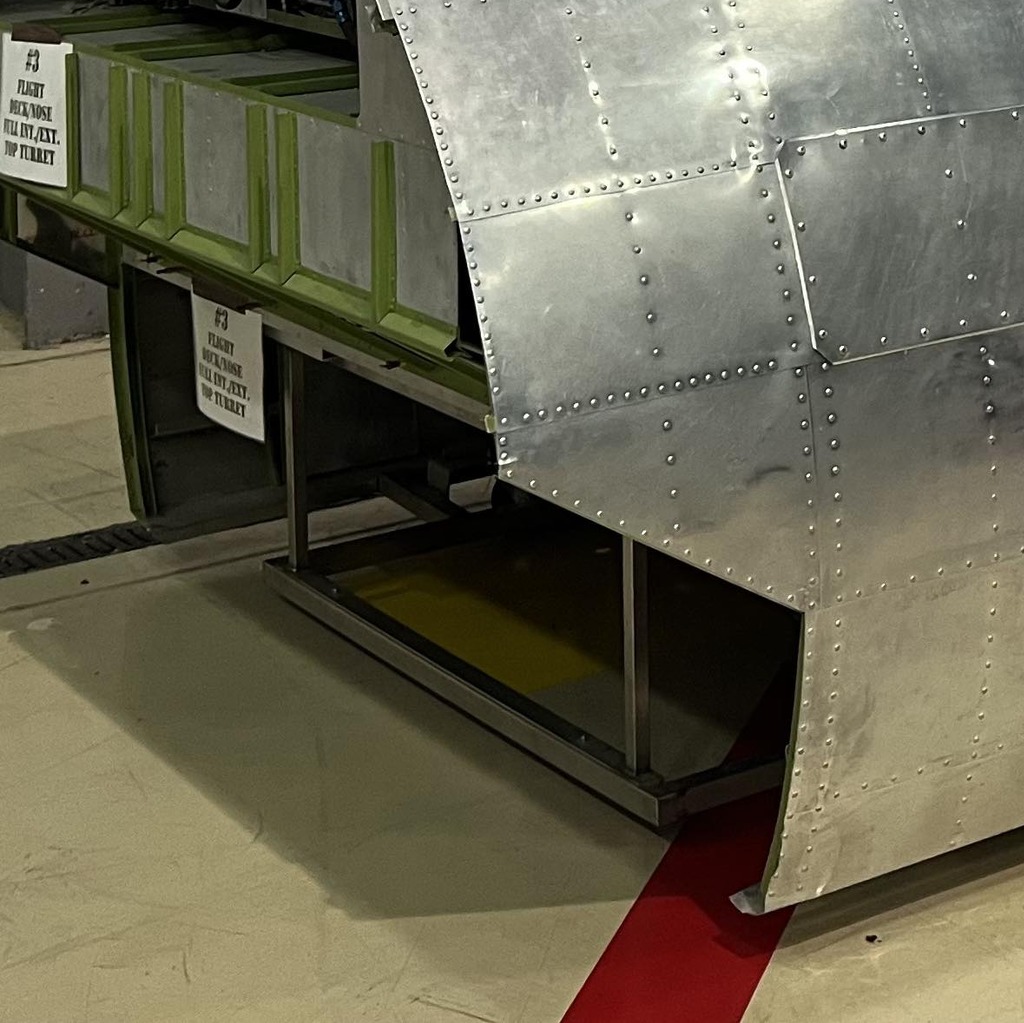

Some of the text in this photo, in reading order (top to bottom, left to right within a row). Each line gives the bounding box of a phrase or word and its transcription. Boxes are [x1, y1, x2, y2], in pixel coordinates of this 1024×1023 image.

[25, 48, 40, 72] #3
[17, 79, 45, 99] FLIGHT
[9, 98, 52, 122] DECK/NOSE
[3, 118, 18, 136] FULL
[4, 140, 55, 166] TOP TURRET
[214, 306, 228, 331] #3
[208, 331, 234, 357] FLIGHT
[199, 362, 212, 383] FULL
[202, 346, 243, 379] DECK/NOSE
[201, 382, 246, 418] TOP TURRET
